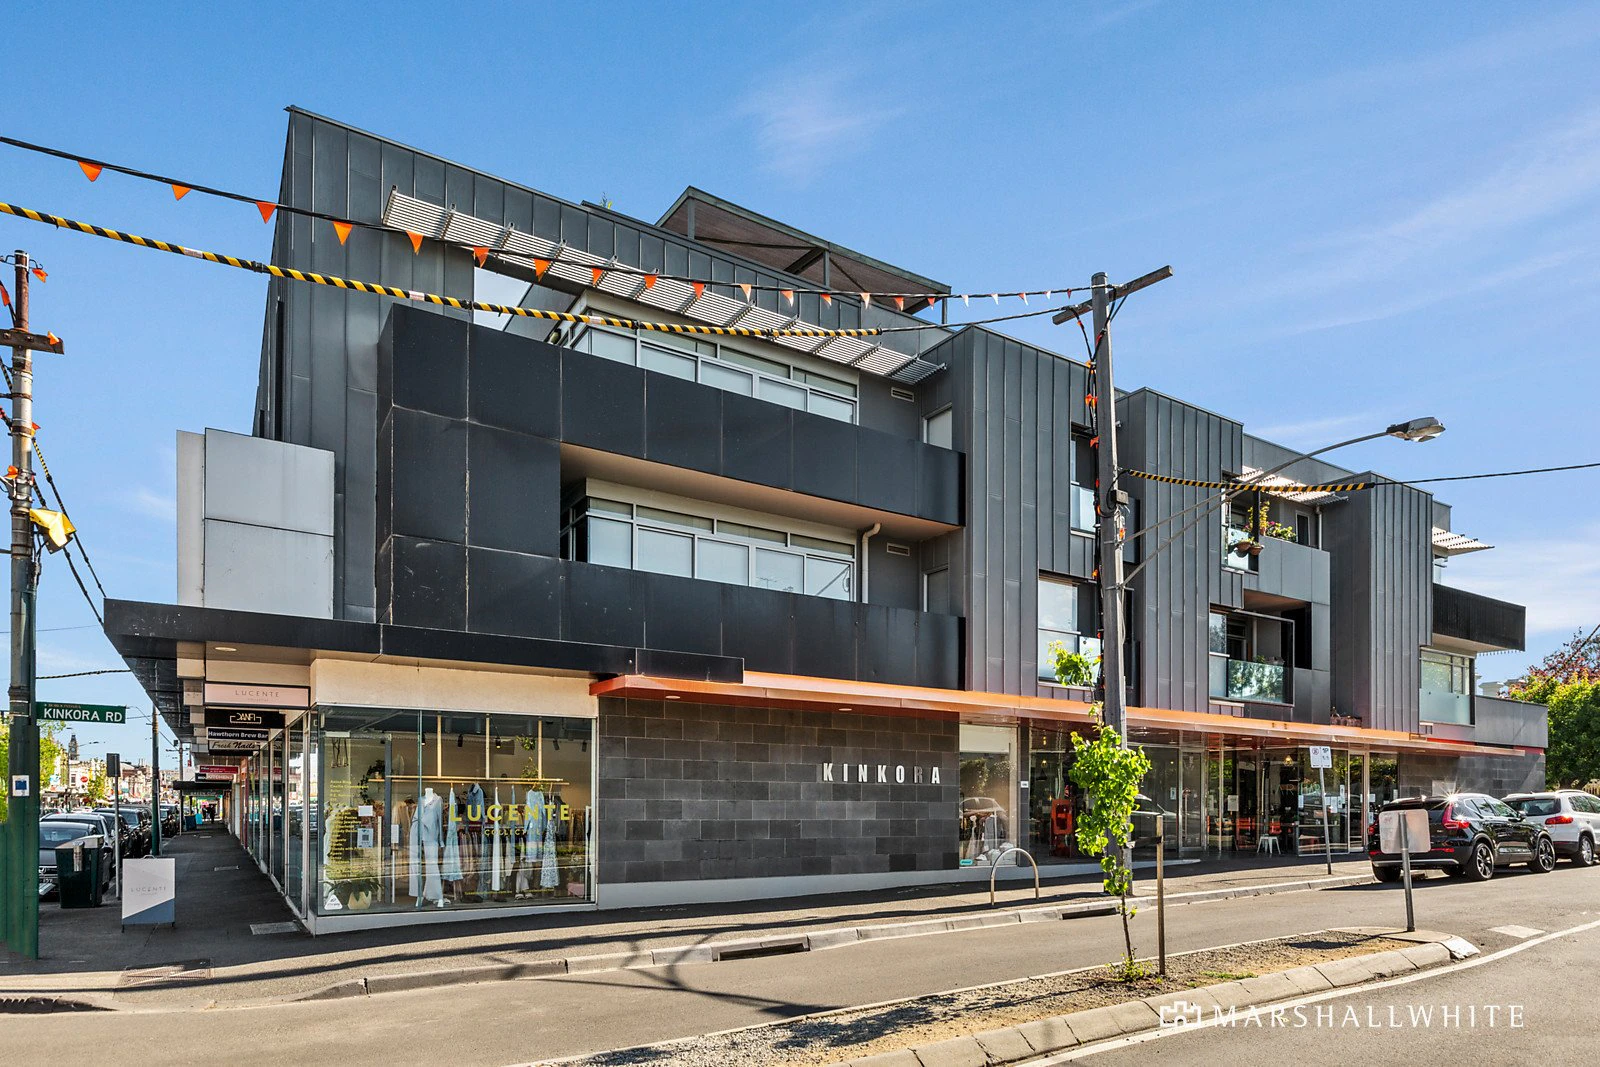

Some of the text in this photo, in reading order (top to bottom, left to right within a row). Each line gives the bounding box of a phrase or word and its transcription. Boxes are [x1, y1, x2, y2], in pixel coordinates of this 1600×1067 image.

[235, 690, 280, 698] LUCENTE
[43, 708, 123, 722] KINKORA RD
[211, 741, 256, 749] Fresh Nails
[823, 763, 941, 784] KINKORA
[449, 804, 570, 822] LUCENTE
